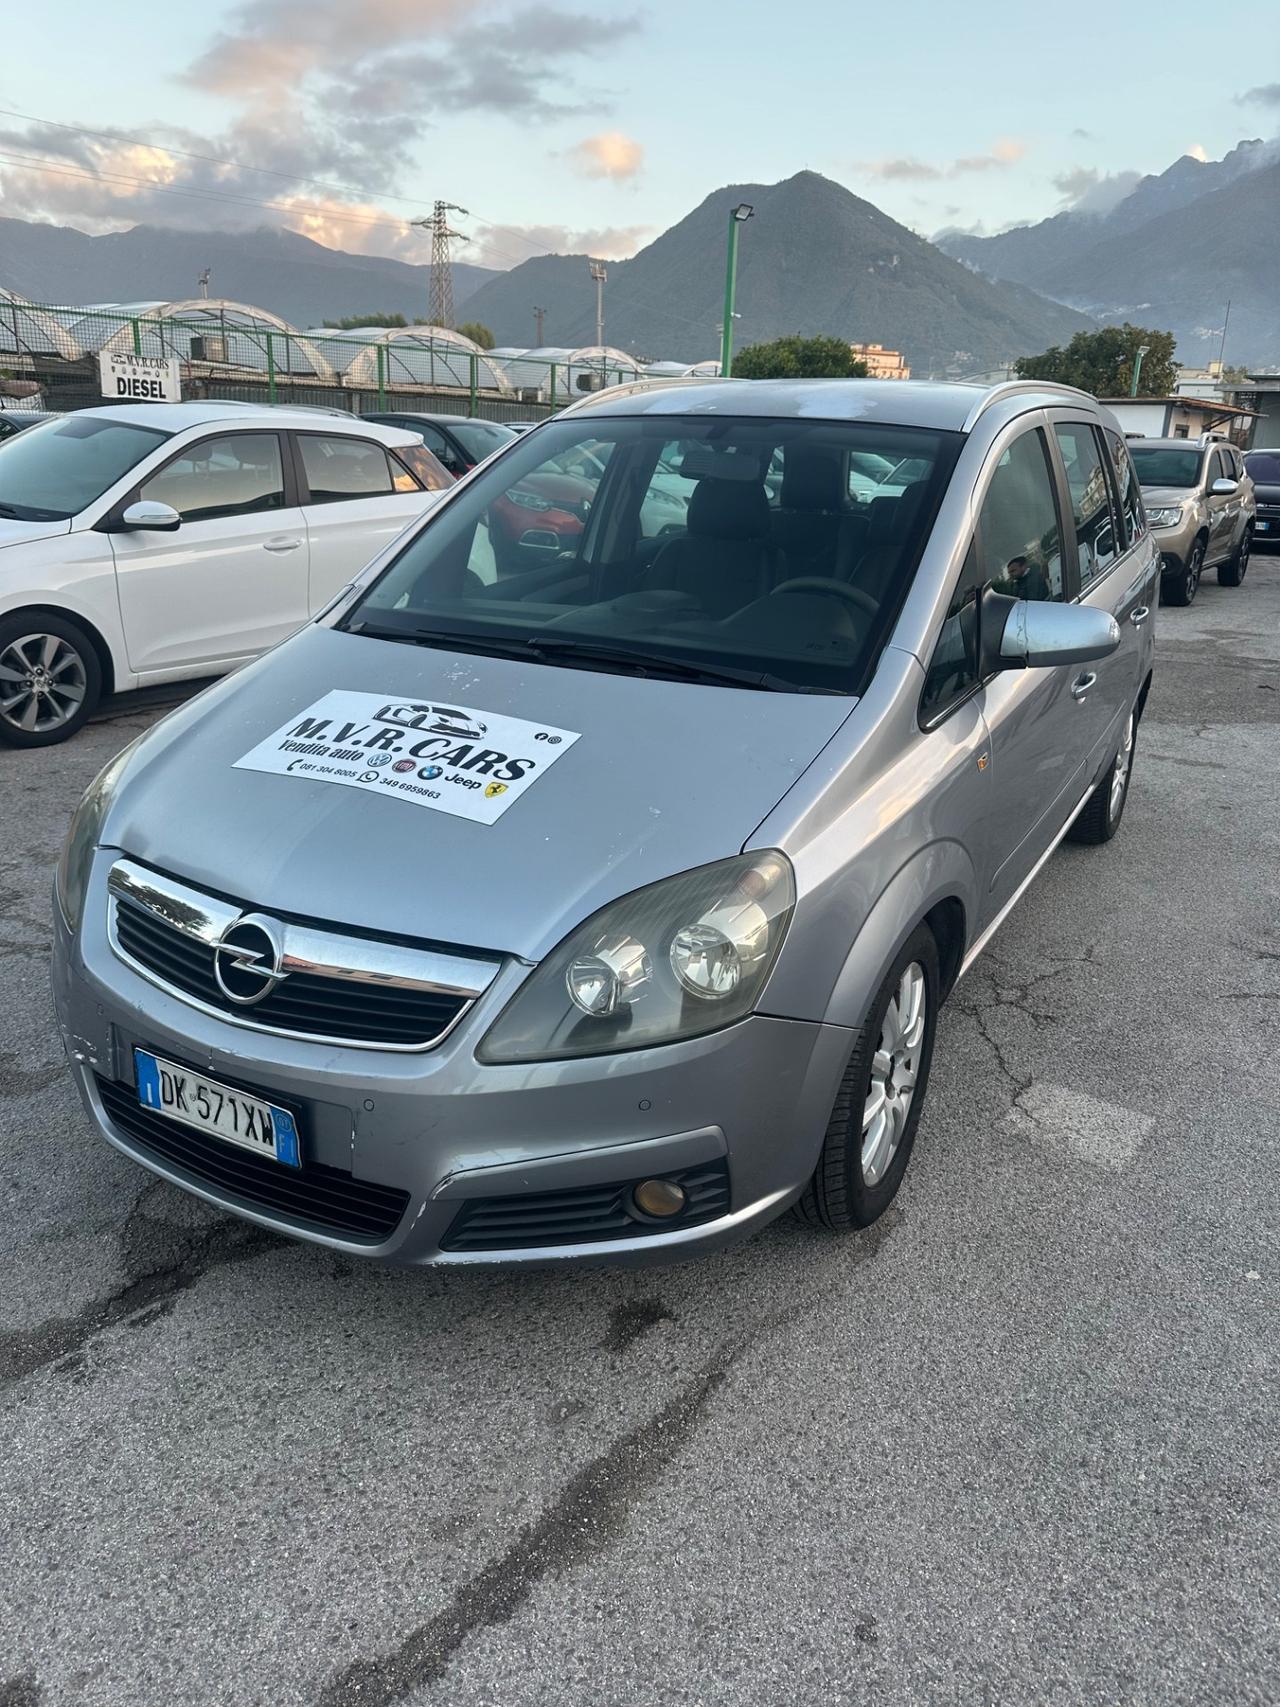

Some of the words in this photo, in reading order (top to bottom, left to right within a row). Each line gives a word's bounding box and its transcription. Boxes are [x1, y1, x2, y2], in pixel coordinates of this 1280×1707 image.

[116, 376, 167, 399] DIESEL
[278, 739, 332, 757] Vendita
[328, 748, 365, 762] auto
[379, 777, 399, 788] 349
[444, 773, 482, 791] Jeep
